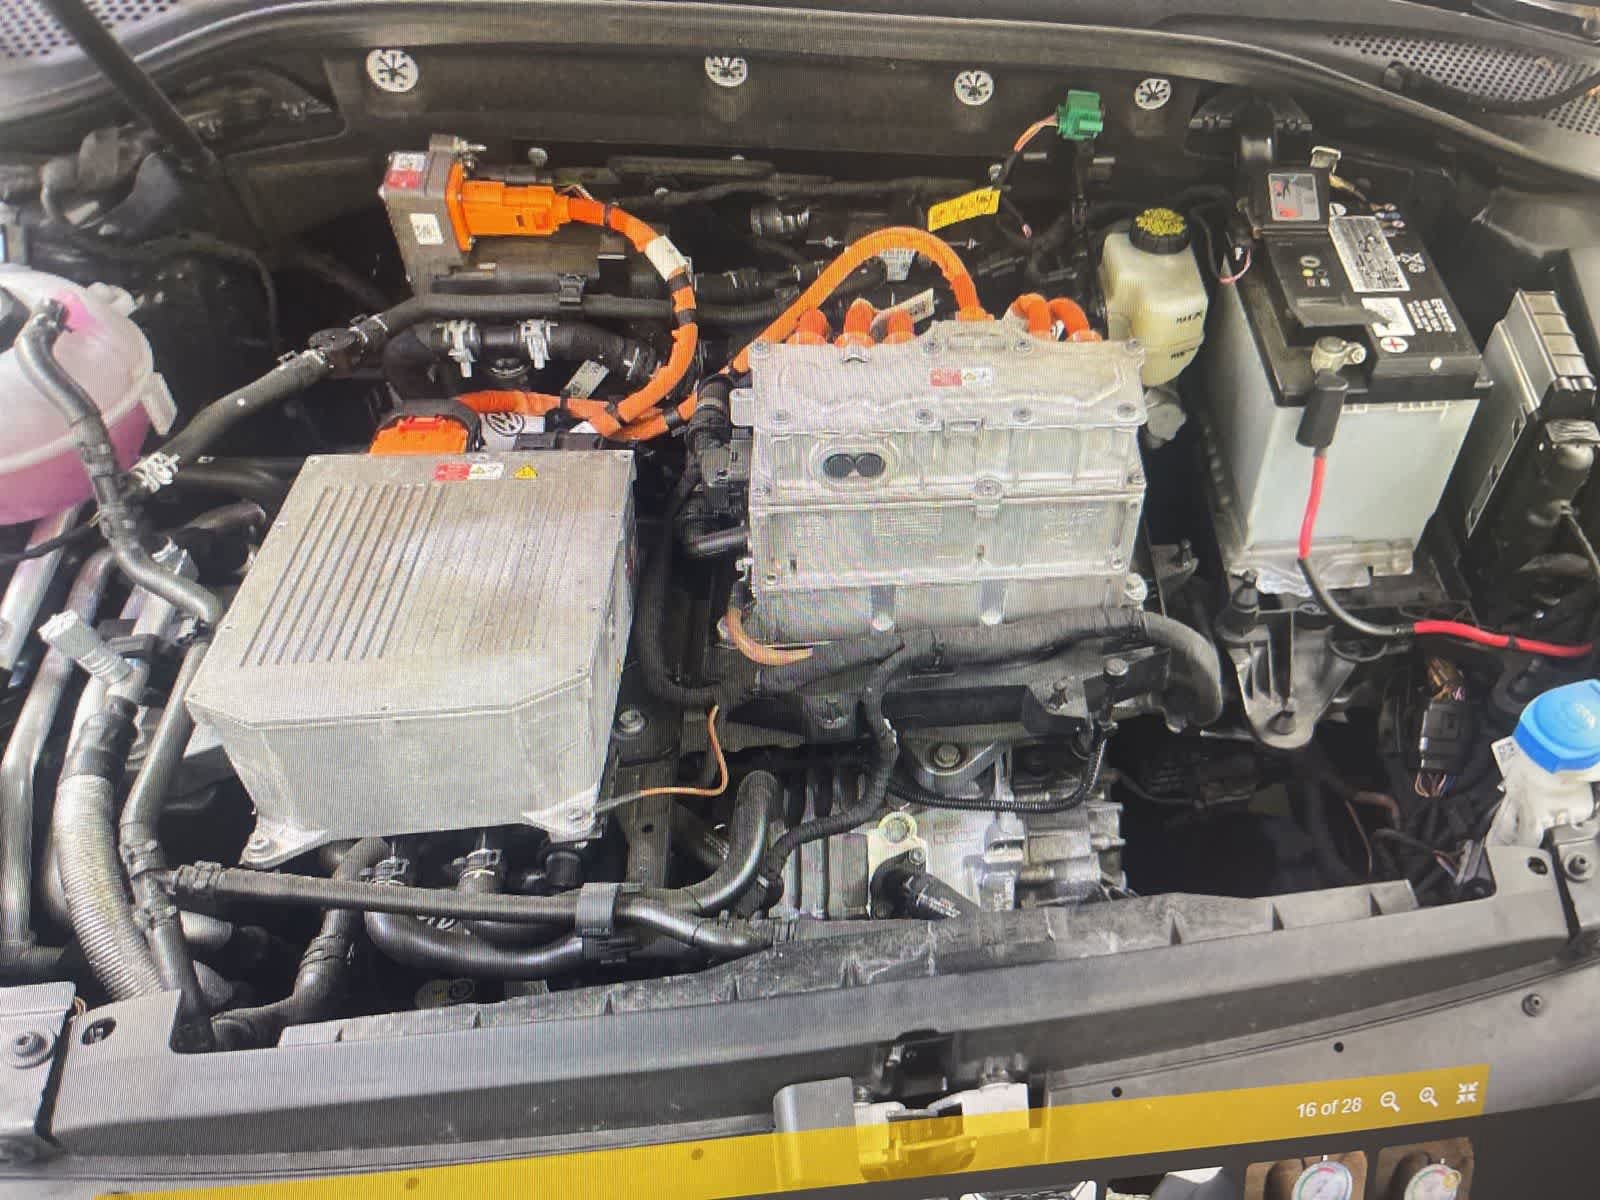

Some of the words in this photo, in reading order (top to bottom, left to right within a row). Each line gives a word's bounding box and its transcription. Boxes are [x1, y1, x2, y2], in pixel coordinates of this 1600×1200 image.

[1296, 1102, 1317, 1118] 16
[1320, 1099, 1340, 1116] of
[1341, 1097, 1363, 1114] 28
